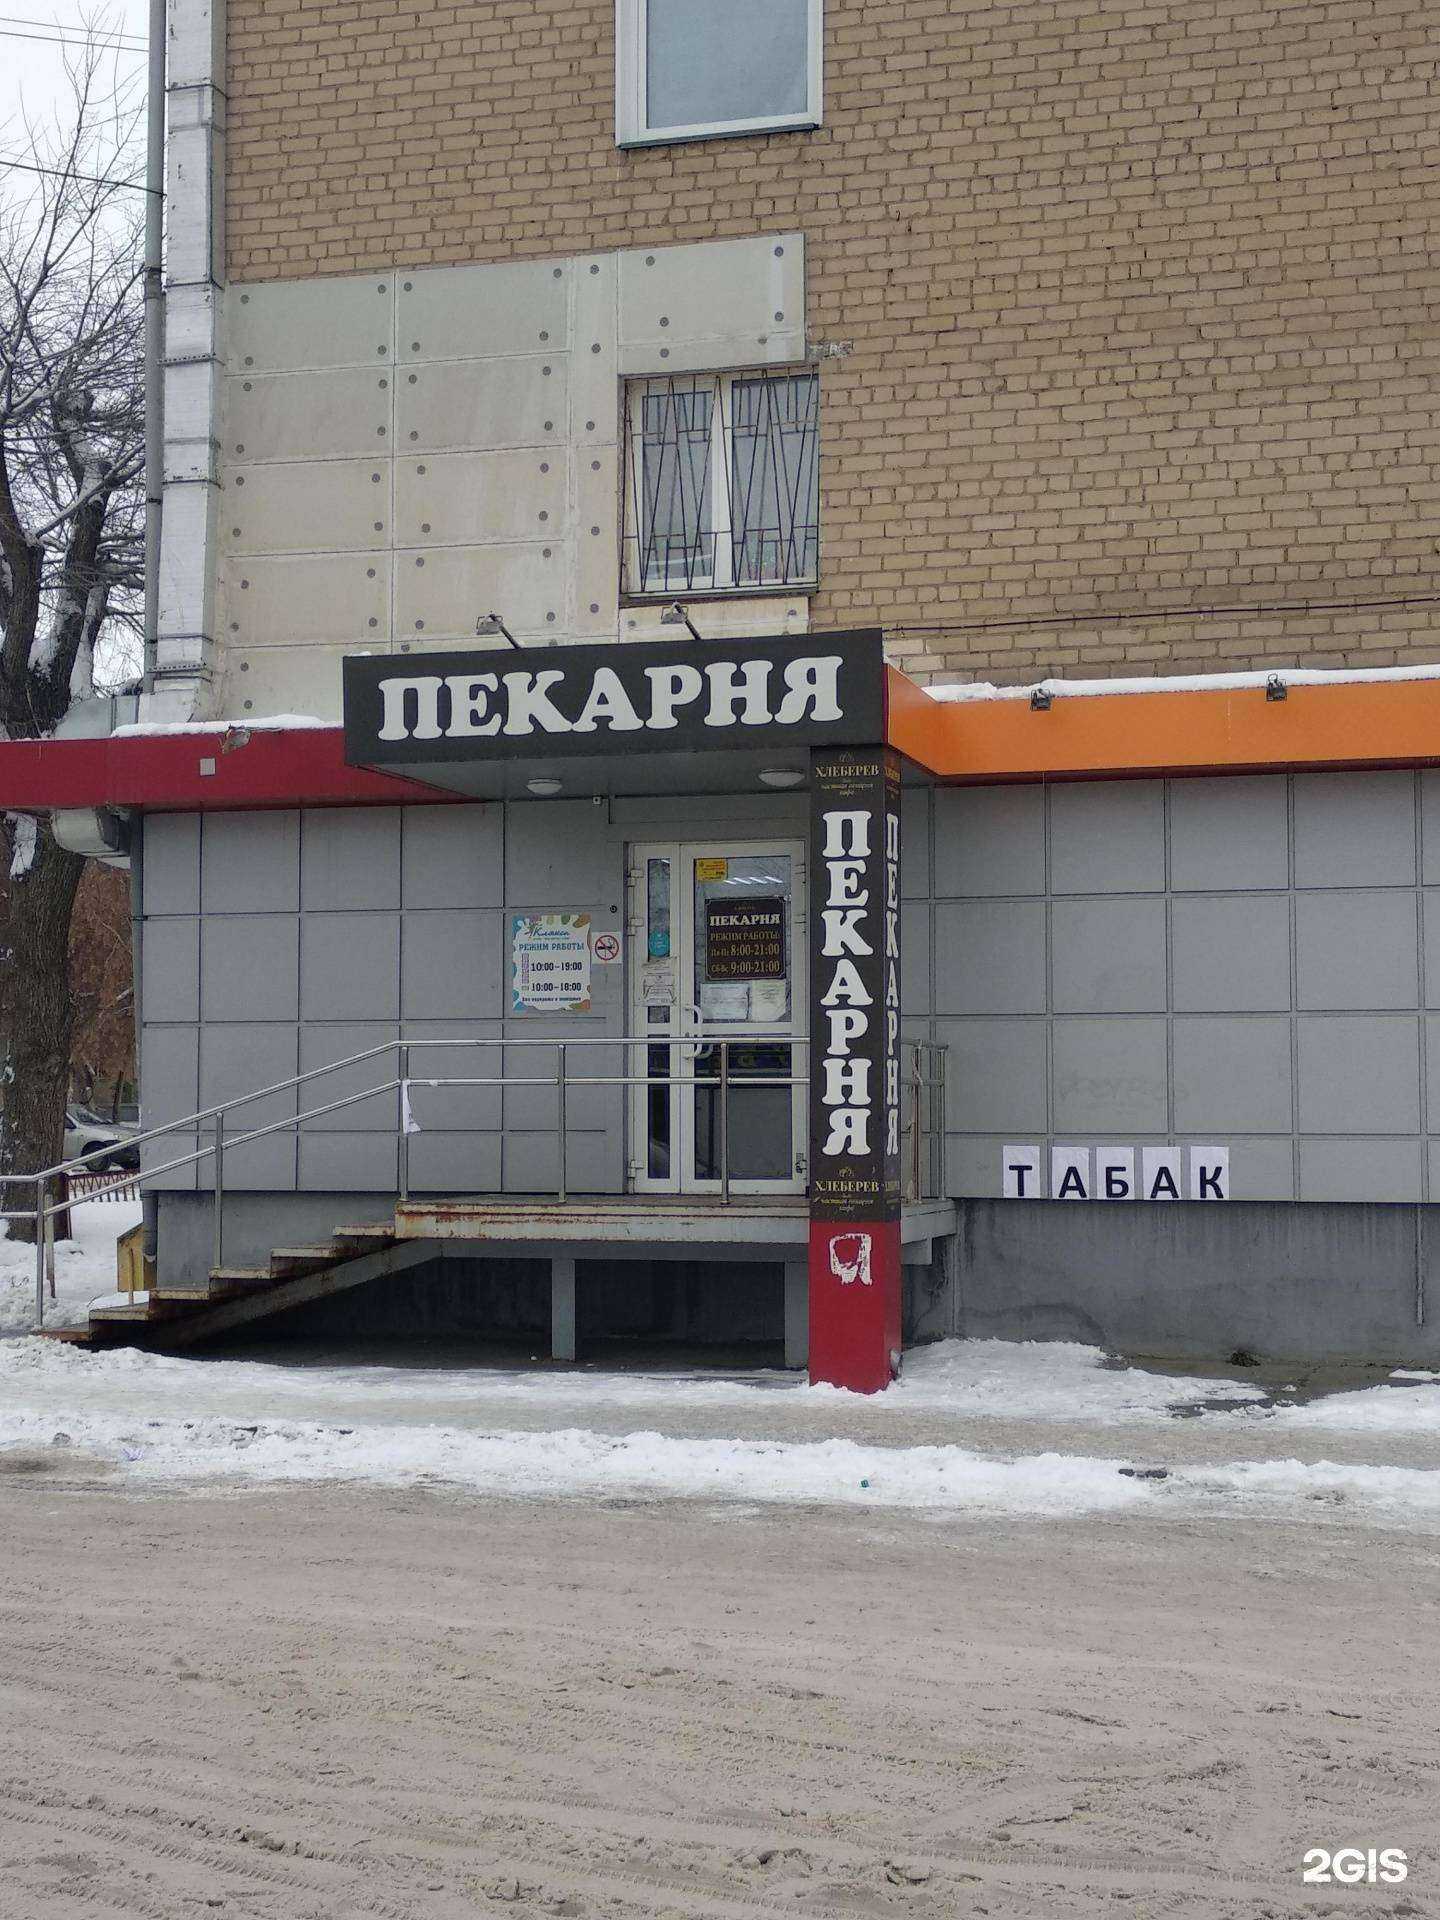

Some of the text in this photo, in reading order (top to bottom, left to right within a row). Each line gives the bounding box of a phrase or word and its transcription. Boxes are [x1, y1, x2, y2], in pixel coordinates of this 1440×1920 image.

[378, 655, 844, 741] ПЕКАРНЯ
[816, 764, 880, 778] ХЛЕБЕРЕВ
[709, 914, 780, 926] ПЕКАРНЯ
[710, 932, 742, 941] РЕЖИМ
[519, 942, 584, 951] РЕЖИМ РАБОТЫ
[820, 811, 874, 1156] ПЕКАРНЯ
[886, 813, 899, 1156] ПЕКАРНЯ
[815, 1180, 880, 1193] ХЛЕБЕРЕВ
[1008, 1165, 1224, 1199] ТАБАК
